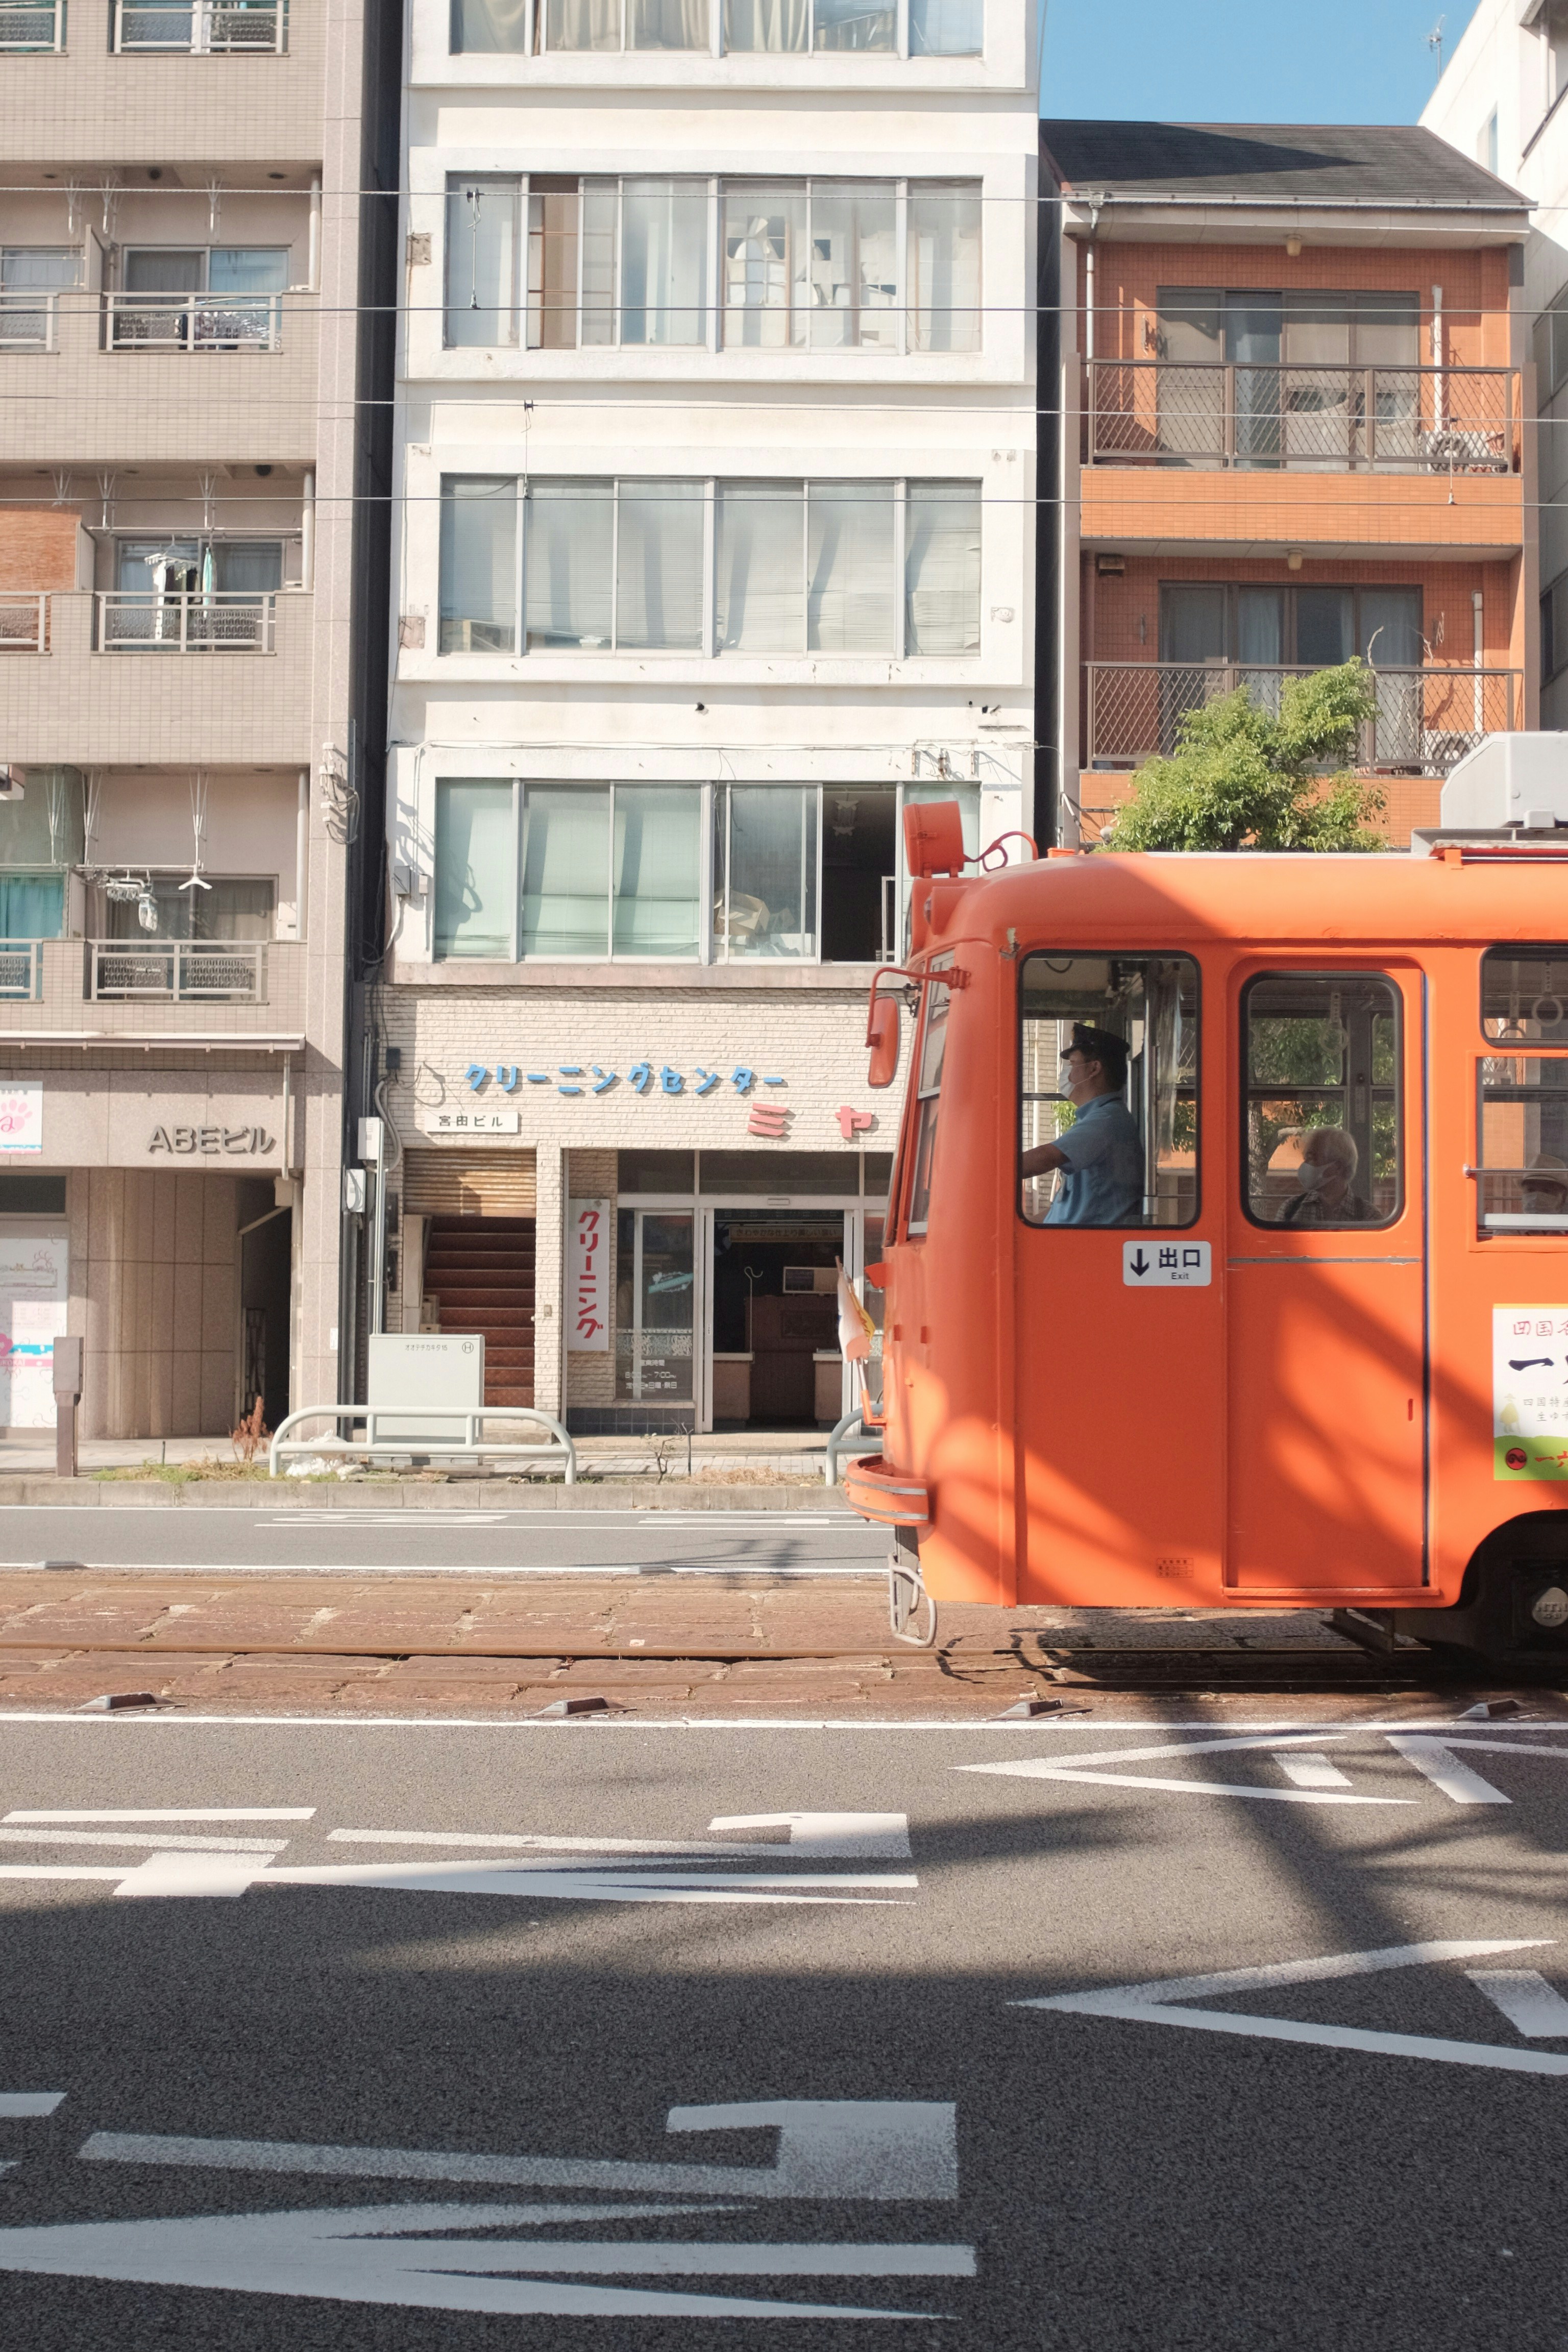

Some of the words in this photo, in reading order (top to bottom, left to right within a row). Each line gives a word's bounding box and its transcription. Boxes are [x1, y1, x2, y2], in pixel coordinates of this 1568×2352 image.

[464, 1062, 783, 1094] クリーニングセンター
[438, 1115, 503, 1127] 宮田ビル
[147, 1125, 277, 1155] ABEビル
[1159, 1247, 1200, 1268] 出口
[576, 1211, 603, 1339] クリーニング
